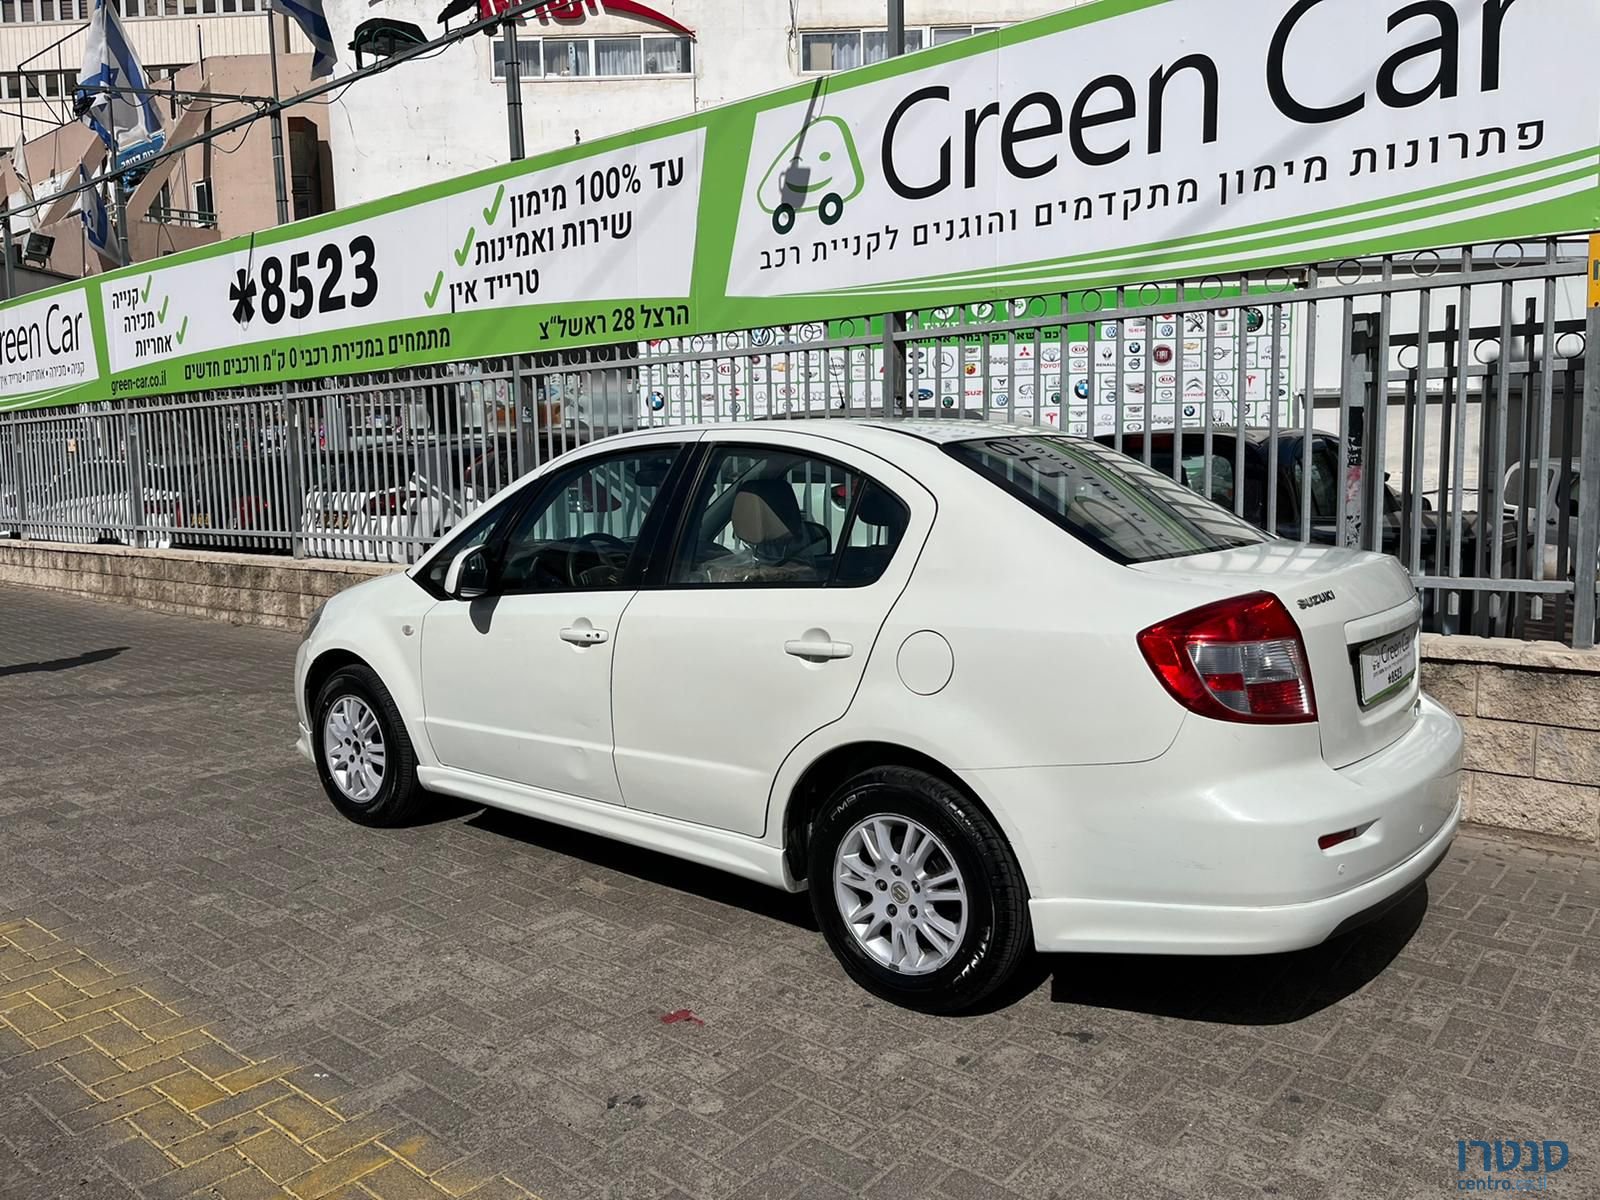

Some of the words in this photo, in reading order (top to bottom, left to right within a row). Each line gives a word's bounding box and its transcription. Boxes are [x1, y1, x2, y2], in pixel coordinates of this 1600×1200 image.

[881, 53, 1219, 200] Green
[1266, 0, 1515, 124] Car
[1349, 119, 1544, 177] פתרונות
[575, 163, 641, 206] 100%
[649, 156, 684, 189] עד
[1218, 155, 1327, 206] מימון
[509, 184, 567, 228] מימון
[1035, 178, 1198, 227] מתקדמים
[561, 210, 632, 250] שירות
[811, 224, 899, 262] לקניית
[913, 208, 1017, 246] והוגנים
[475, 226, 554, 266] ואמינות
[759, 246, 800, 270] רכב
[112, 287, 139, 311] קנייה
[449, 279, 478, 314] אין
[483, 268, 540, 300] טרייד
[124, 311, 155, 333] מכירה
[612, 306, 635, 332] 28
[640, 304, 689, 329] הרצל
[0, 322, 41, 365] reen
[46, 303, 83, 356] Car
[135, 334, 173, 358] אחריות
[388, 327, 451, 355] מתמחים
[223, 355, 260, 376] ורכבים
[299, 346, 328, 367] רכבי
[332, 338, 384, 363] במכירת
[111, 369, 167, 396] green-car.co.il
[184, 360, 220, 381] חדשים
[1297, 590, 1336, 610] SUZUKI
